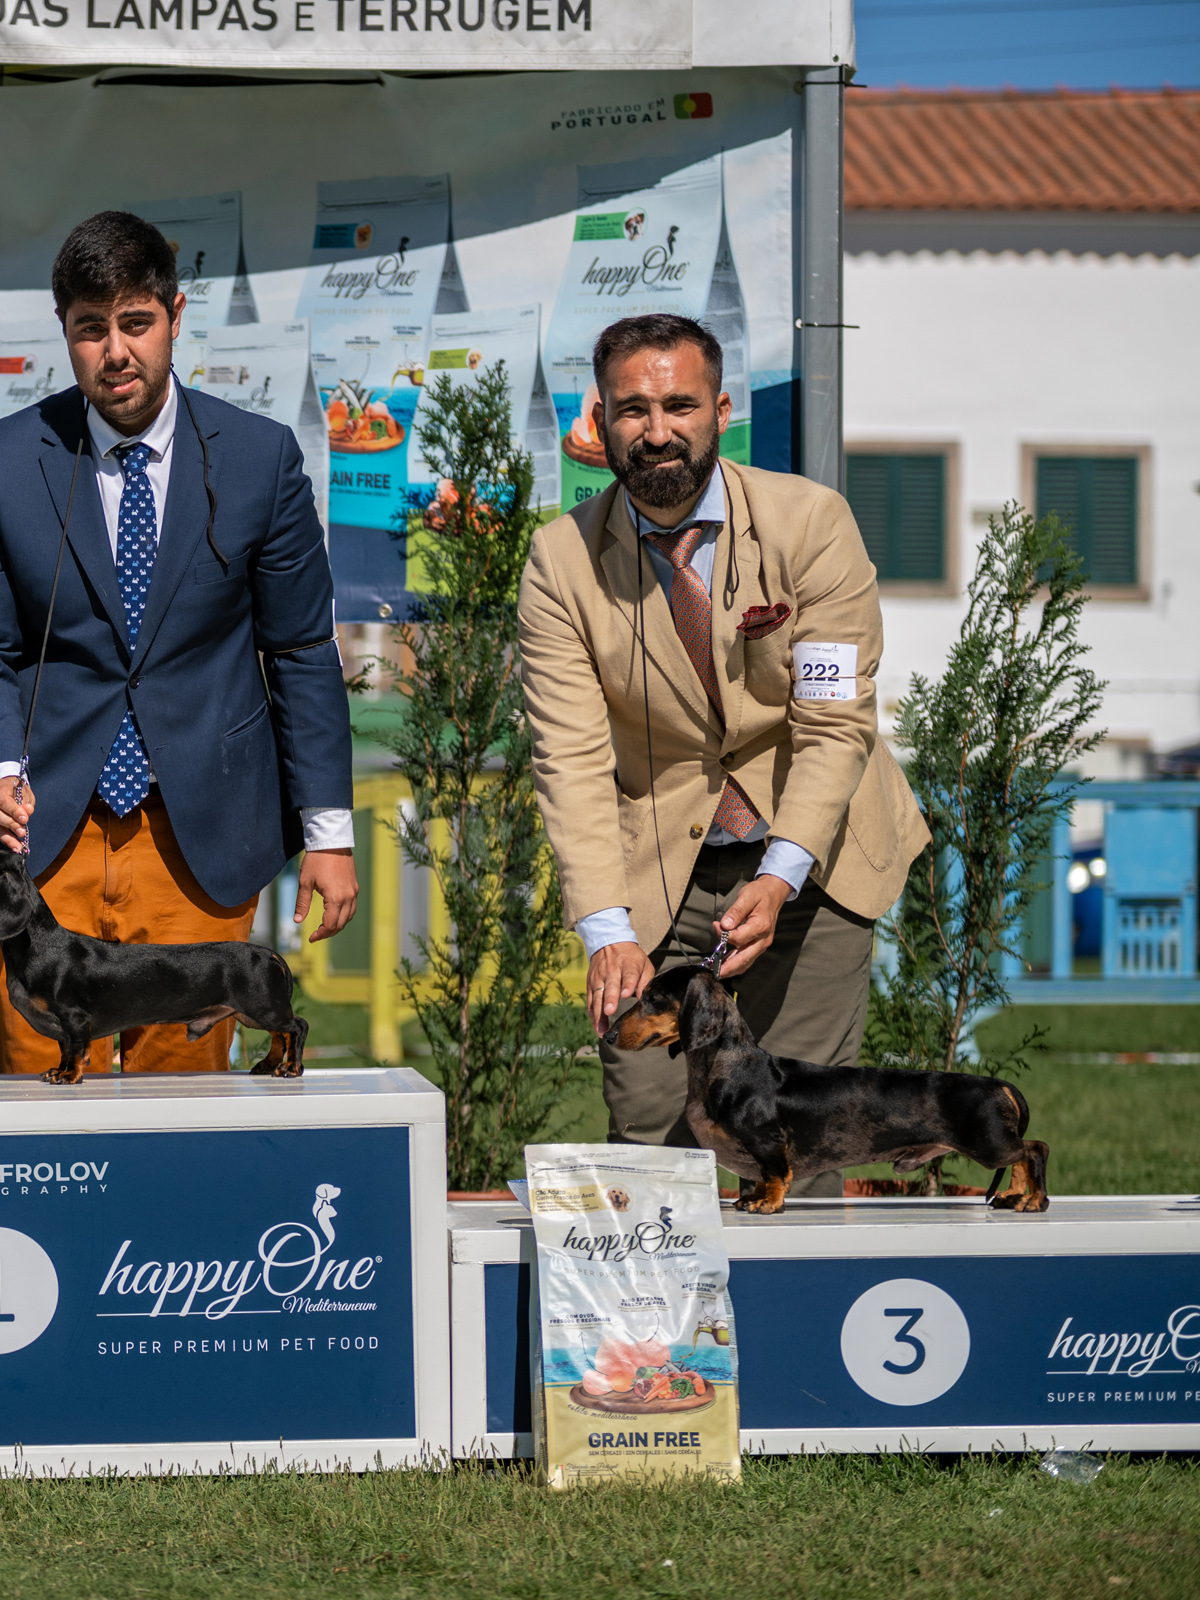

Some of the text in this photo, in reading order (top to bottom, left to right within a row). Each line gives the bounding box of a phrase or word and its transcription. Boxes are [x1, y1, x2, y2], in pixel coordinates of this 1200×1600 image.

[87, 0, 278, 30] LAMPAS
[295, 3, 315, 31] E
[325, 0, 592, 31] TERRUGEM
[561, 98, 665, 119] FABRICADO EM
[551, 110, 666, 130] PORTUGAL
[356, 472, 392, 490] FREE
[802, 663, 840, 682] 222
[563, 1266, 700, 1278] SUPER PREMIUM PET FOOD
[282, 1295, 377, 1315] Mediterraneum
[97, 1336, 379, 1356] SUPER PREMIUM PET FOOD
[882, 1308, 927, 1375] 3
[1047, 1305, 1200, 1378] happyO
[1047, 1390, 1200, 1403] SUPER PREMIUM PE
[588, 1431, 701, 1449] GRAIN FREE
